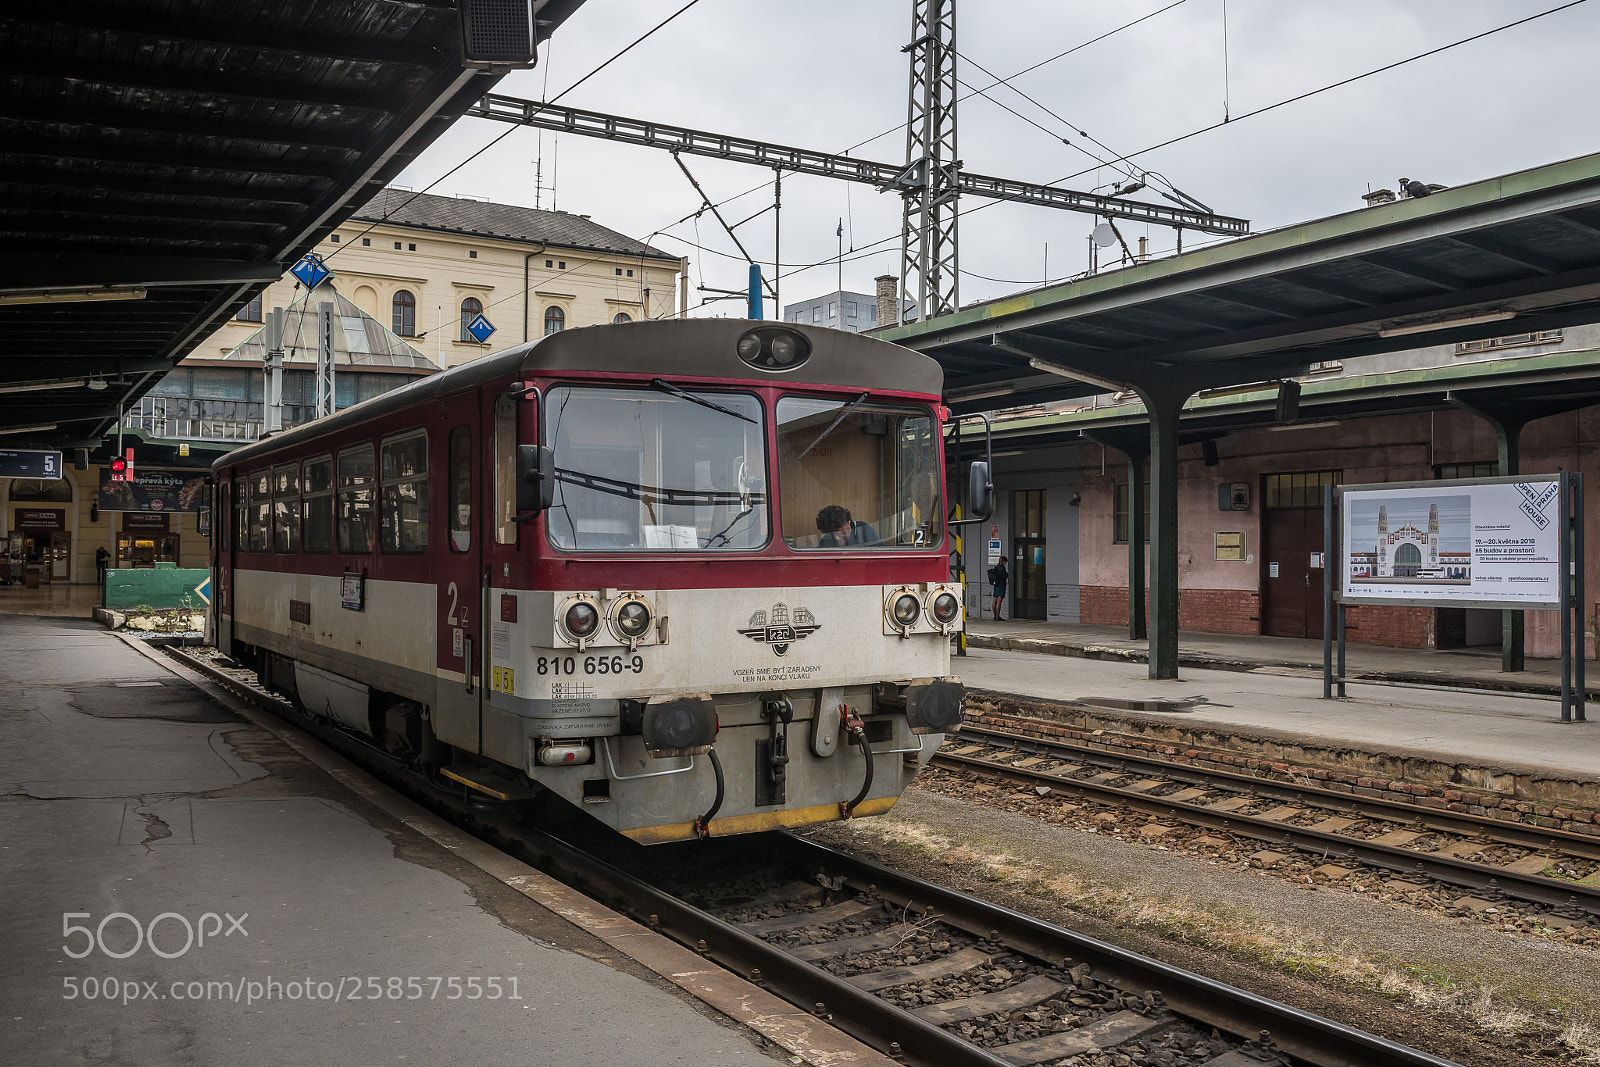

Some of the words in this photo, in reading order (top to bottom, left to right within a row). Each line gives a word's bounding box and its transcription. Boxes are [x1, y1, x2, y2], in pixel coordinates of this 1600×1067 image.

[164, 477, 183, 486] kýta
[1518, 482, 1536, 501] OPEN
[1536, 484, 1558, 508] PRAHA
[1523, 503, 1546, 526] HOUSE
[916, 530, 924, 543] 2
[1508, 546, 1536, 555] prostorů
[447, 581, 458, 626] 2
[536, 656, 576, 675] 810
[583, 655, 644, 675] 656-9
[742, 675, 755, 683] LEN
